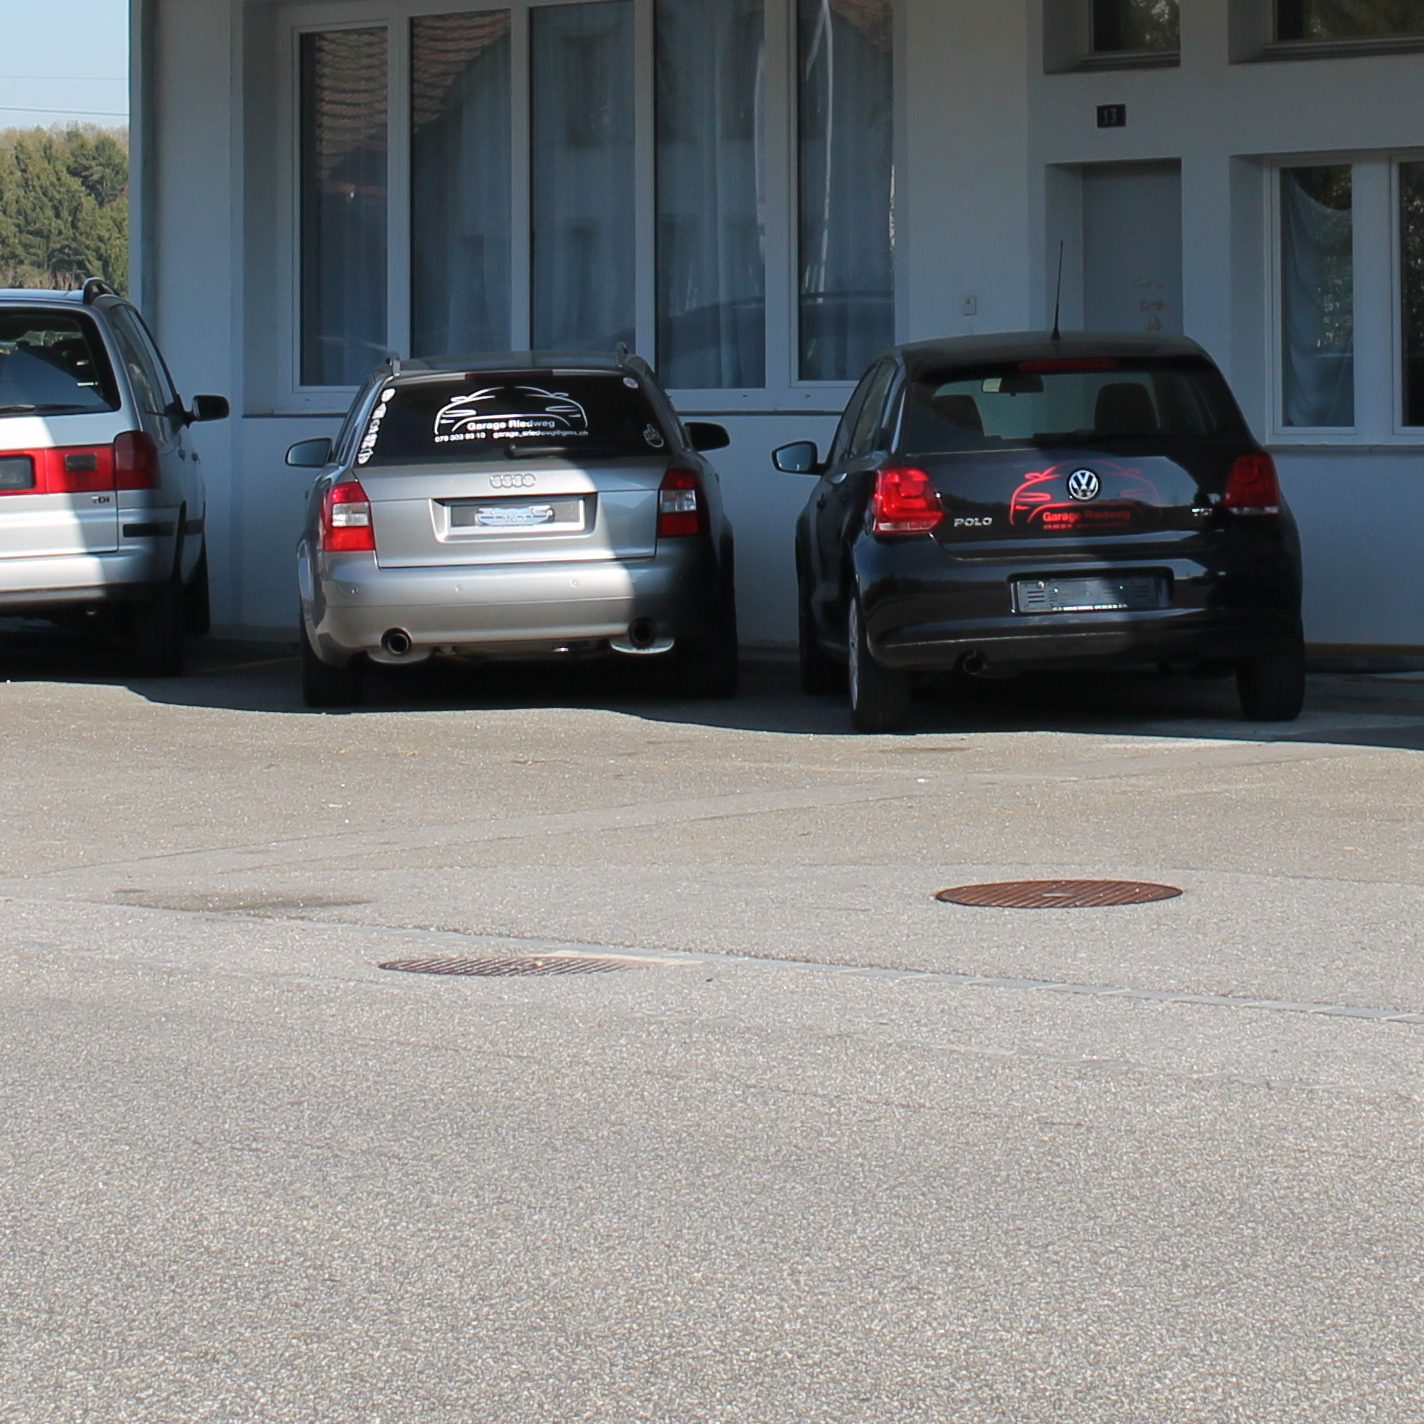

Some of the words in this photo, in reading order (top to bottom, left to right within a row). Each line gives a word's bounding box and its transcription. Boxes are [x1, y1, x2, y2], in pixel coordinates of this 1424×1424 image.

[1103, 107, 1117, 124] 13
[466, 421, 506, 431] Garage
[508, 419, 555, 428] Riedweg
[954, 517, 993, 527] POLO
[1042, 511, 1082, 523] Garage
